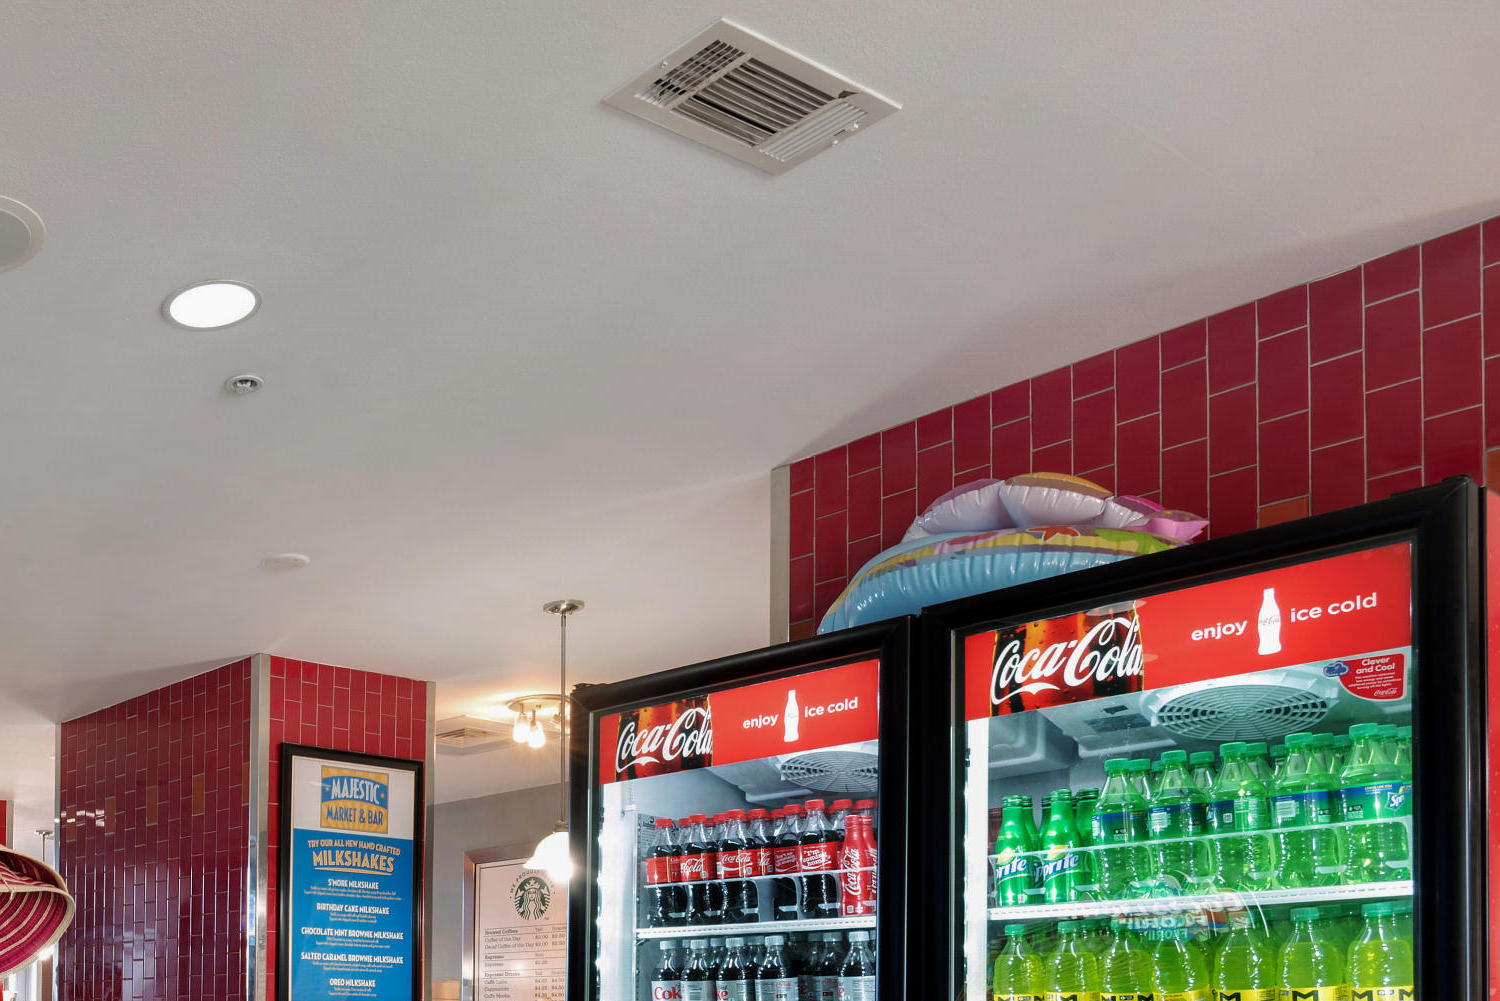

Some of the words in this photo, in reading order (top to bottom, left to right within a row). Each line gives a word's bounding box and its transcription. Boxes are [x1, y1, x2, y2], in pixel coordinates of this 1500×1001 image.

[1191, 619, 1247, 642] enjoy
[1290, 603, 1322, 623] ice
[1328, 592, 1378, 615] cold
[990, 616, 1143, 705] Coca-Cola
[1356, 666, 1373, 674] and
[1375, 663, 1395, 671] Cool
[1362, 657, 1390, 666] Clever
[743, 713, 779, 729] enjoy
[804, 706, 825, 717] ice
[827, 697, 858, 714] cold
[616, 706, 713, 773] Coca-Cola
[331, 778, 380, 804] MAJESTIC
[326, 806, 356, 823] MARKET
[360, 810, 365, 824] &
[368, 811, 383, 826] BAR
[308, 840, 320, 848] TRY
[320, 839, 333, 847] OUR
[334, 839, 344, 847] ALL
[346, 840, 359, 848] NEW
[359, 841, 375, 850] HAND
[376, 842, 401, 856] CRAFTED
[313, 850, 395, 872] MILKSHAKES
[328, 878, 348, 888] S'MORE
[349, 880, 379, 890] MILKSHAKE
[316, 903, 343, 912] BIRTHDAY
[344, 904, 359, 913] CAKE
[359, 905, 390, 915] MILKSHAKE
[301, 927, 333, 936] CHOCOLATE
[334, 929, 347, 937] MINT
[348, 929, 373, 938] BROWNIE
[373, 931, 404, 940] MILKSHAKE
[301, 952, 321, 960] SALTED
[321, 953, 347, 962] CARAMEL
[348, 954, 373, 963] BROWNIE
[373, 955, 404, 964] MILKSHAKE
[329, 978, 345, 986] OREO
[345, 979, 376, 987] MILKSHAKE
